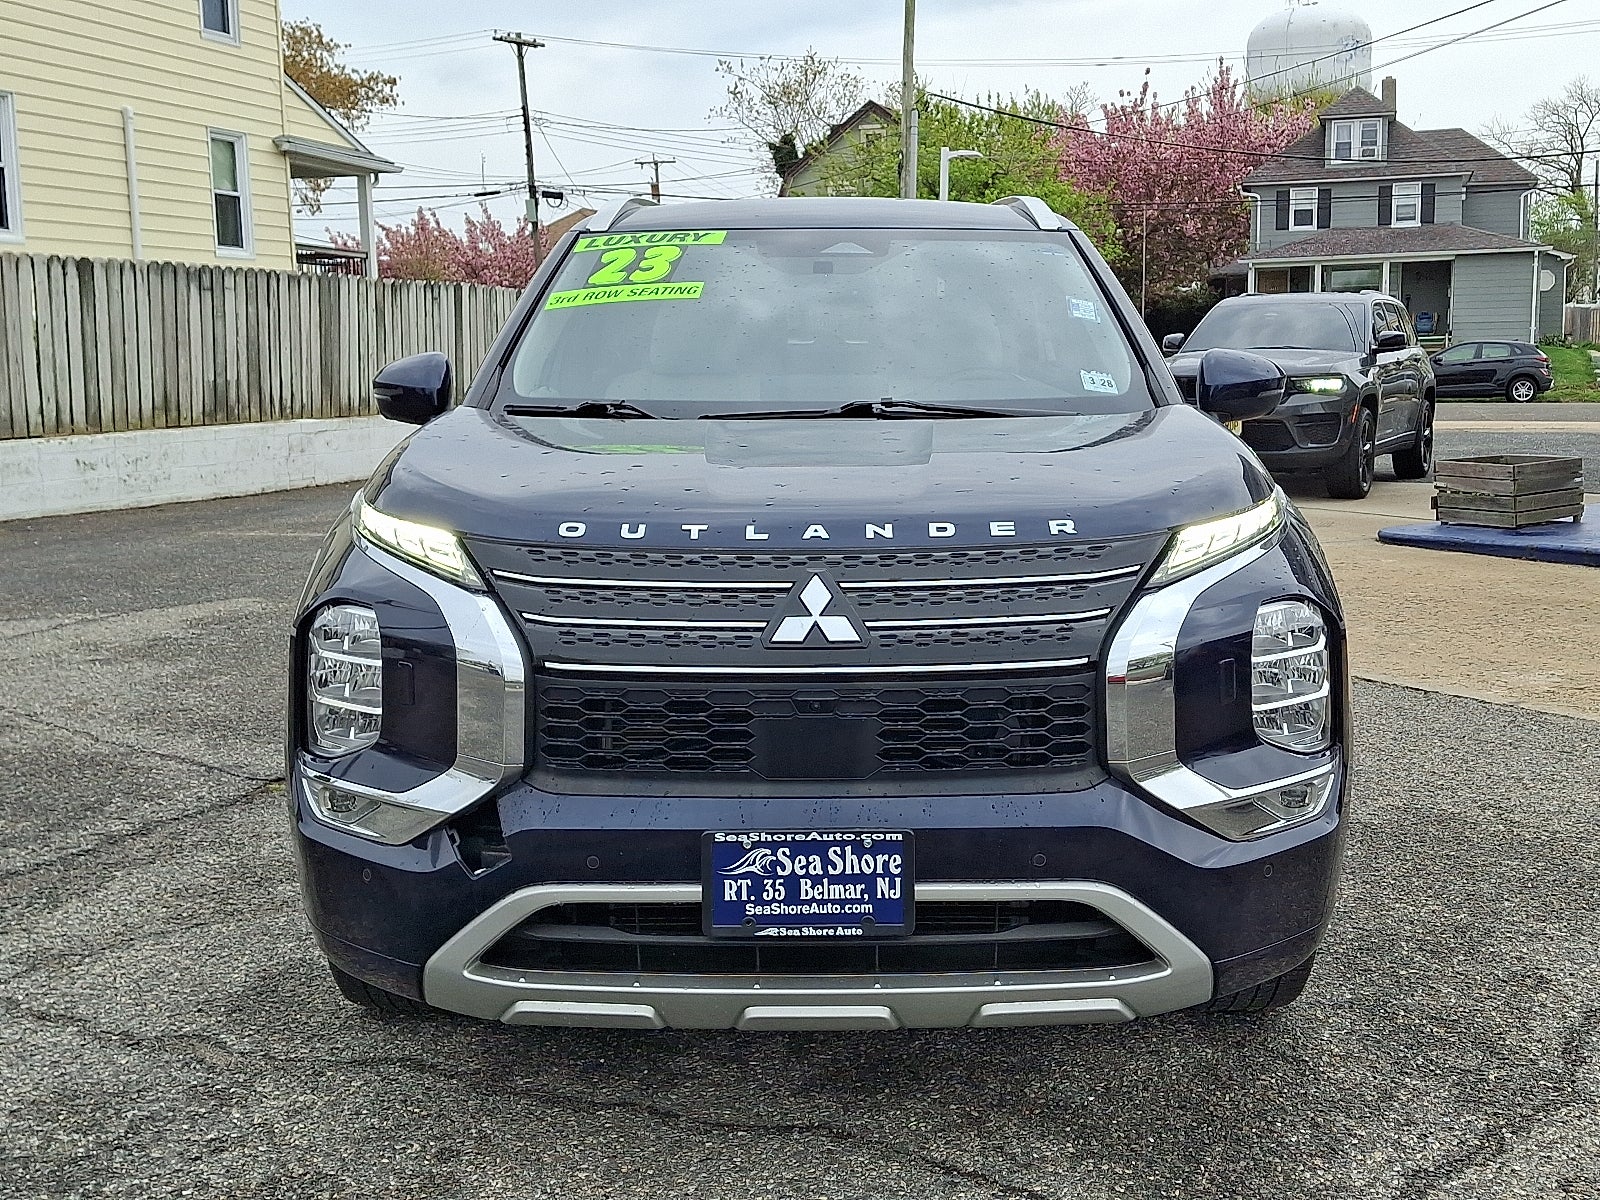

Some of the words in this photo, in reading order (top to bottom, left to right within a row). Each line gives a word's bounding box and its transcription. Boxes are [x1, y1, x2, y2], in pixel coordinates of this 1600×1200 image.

[584, 232, 712, 249] LUXURY
[587, 245, 683, 285] 23
[550, 294, 578, 305] 3rd
[583, 289, 624, 301] ROW
[627, 286, 699, 298] SEATING
[1088, 376, 1096, 385] 3
[1100, 378, 1114, 388] 28
[557, 518, 1078, 541] OUTLANDER
[714, 831, 903, 842] SeaShoreAuto.com
[776, 847, 823, 876] Sea
[827, 845, 902, 875] Shore
[723, 879, 755, 901] RT.
[762, 879, 785, 901] 35
[799, 877, 868, 902] Belmar,
[876, 877, 901, 899] NJ
[745, 903, 873, 915] SeaShoreAuto.com
[779, 927, 800, 936] Sea
[801, 927, 835, 936] Shore
[836, 926, 863, 936] Auto
